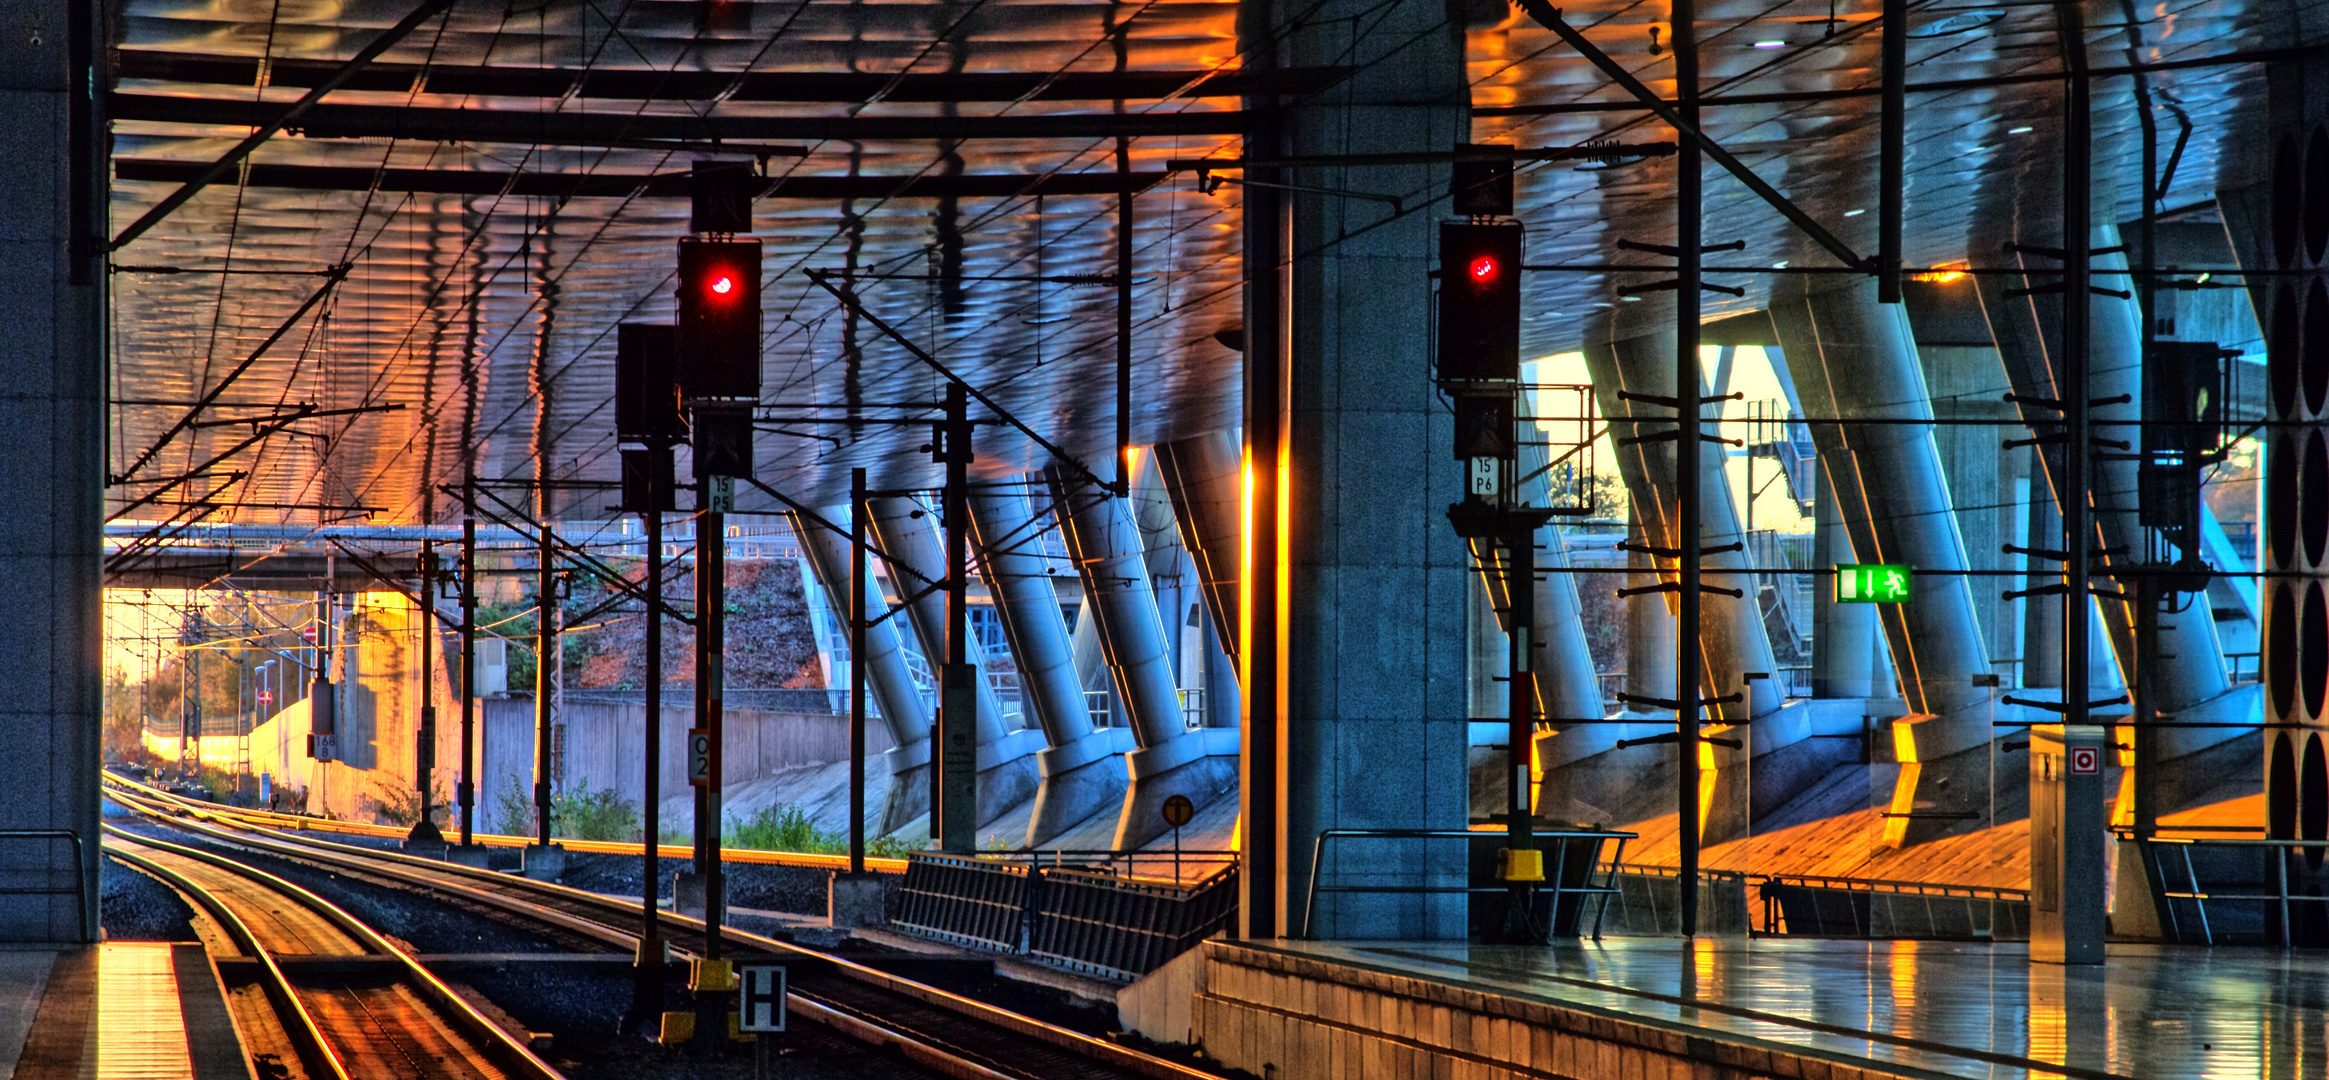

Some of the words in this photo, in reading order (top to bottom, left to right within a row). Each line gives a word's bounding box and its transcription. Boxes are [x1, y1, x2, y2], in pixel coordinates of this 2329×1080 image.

[1478, 459, 1491, 473] 15
[715, 478, 729, 493] 15
[1477, 477, 1492, 493] P6
[713, 496, 729, 511] P5
[316, 736, 336, 747] 168
[321, 747, 329, 758] 8
[697, 757, 708, 775] 2
[745, 970, 782, 1027] H
